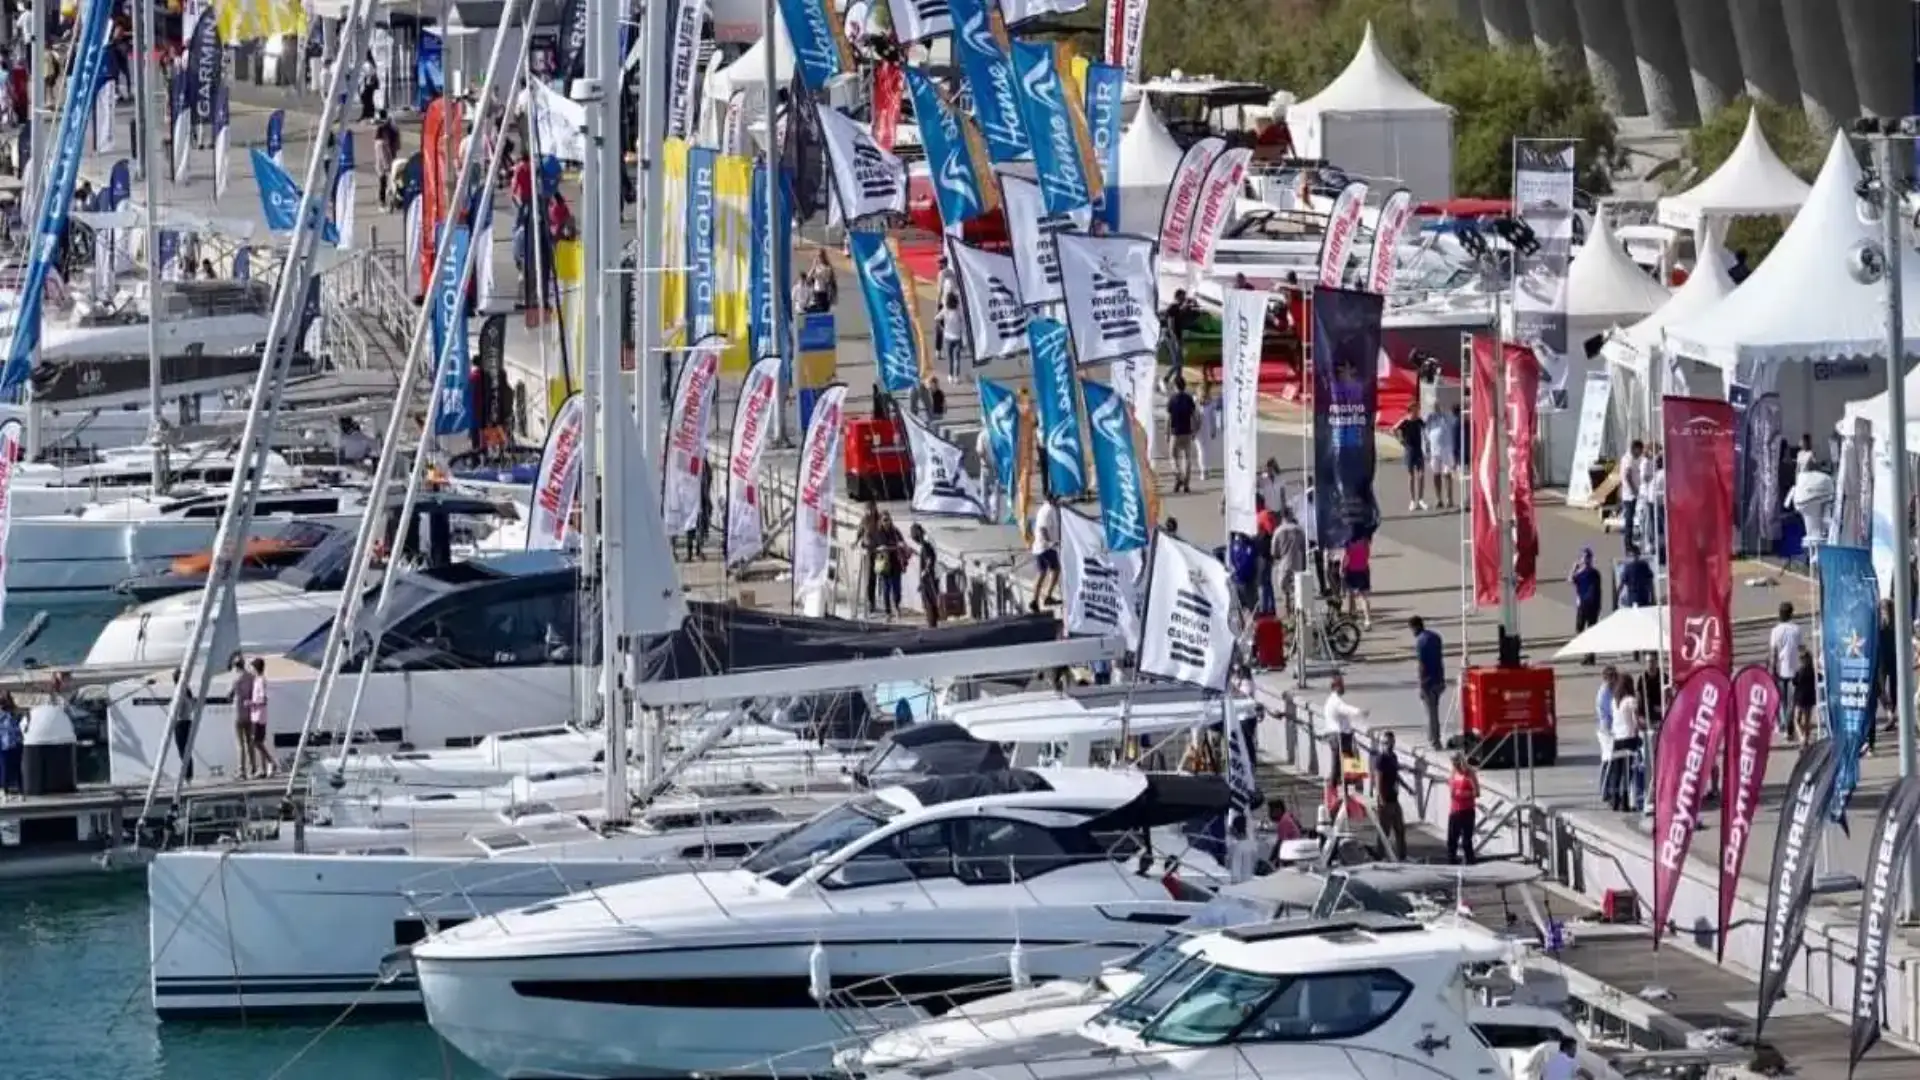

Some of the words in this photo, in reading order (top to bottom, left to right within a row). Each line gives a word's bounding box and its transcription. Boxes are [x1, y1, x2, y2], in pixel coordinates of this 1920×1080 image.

[197, 17, 215, 117] GARMIN
[671, 6, 696, 134] UICKSILVER
[985, 62, 1029, 147] Hanse
[1042, 114, 1089, 207] Hanse
[697, 167, 712, 303] DUFOUR
[1106, 453, 1147, 543] Hanse
[1681, 616, 1720, 661] 50
[1660, 682, 1719, 871] Raymarine
